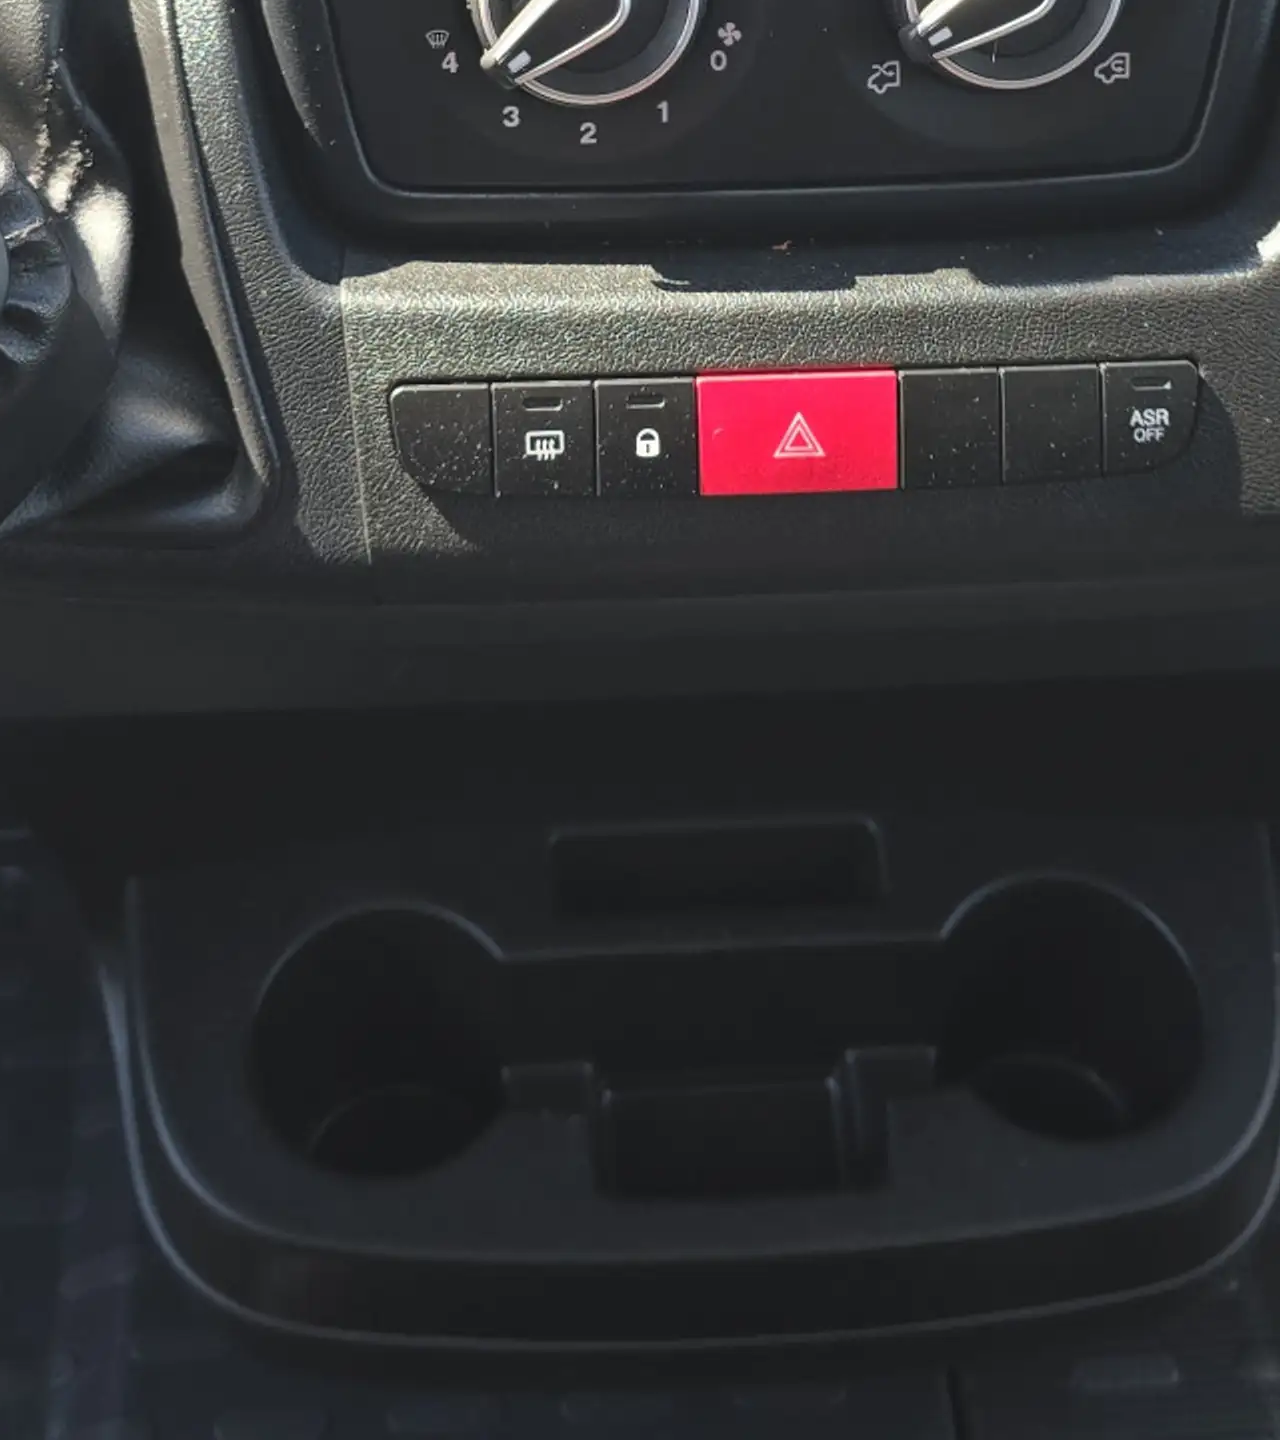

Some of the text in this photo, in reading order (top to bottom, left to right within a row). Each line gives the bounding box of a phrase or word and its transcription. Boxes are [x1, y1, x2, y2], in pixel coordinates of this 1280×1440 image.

[441, 51, 459, 73] 4
[710, 50, 728, 71] 0
[502, 106, 520, 127] 3
[656, 101, 669, 123] 1
[580, 122, 597, 144] 2
[1129, 408, 1170, 427] ASR
[1133, 427, 1165, 443] OFF
